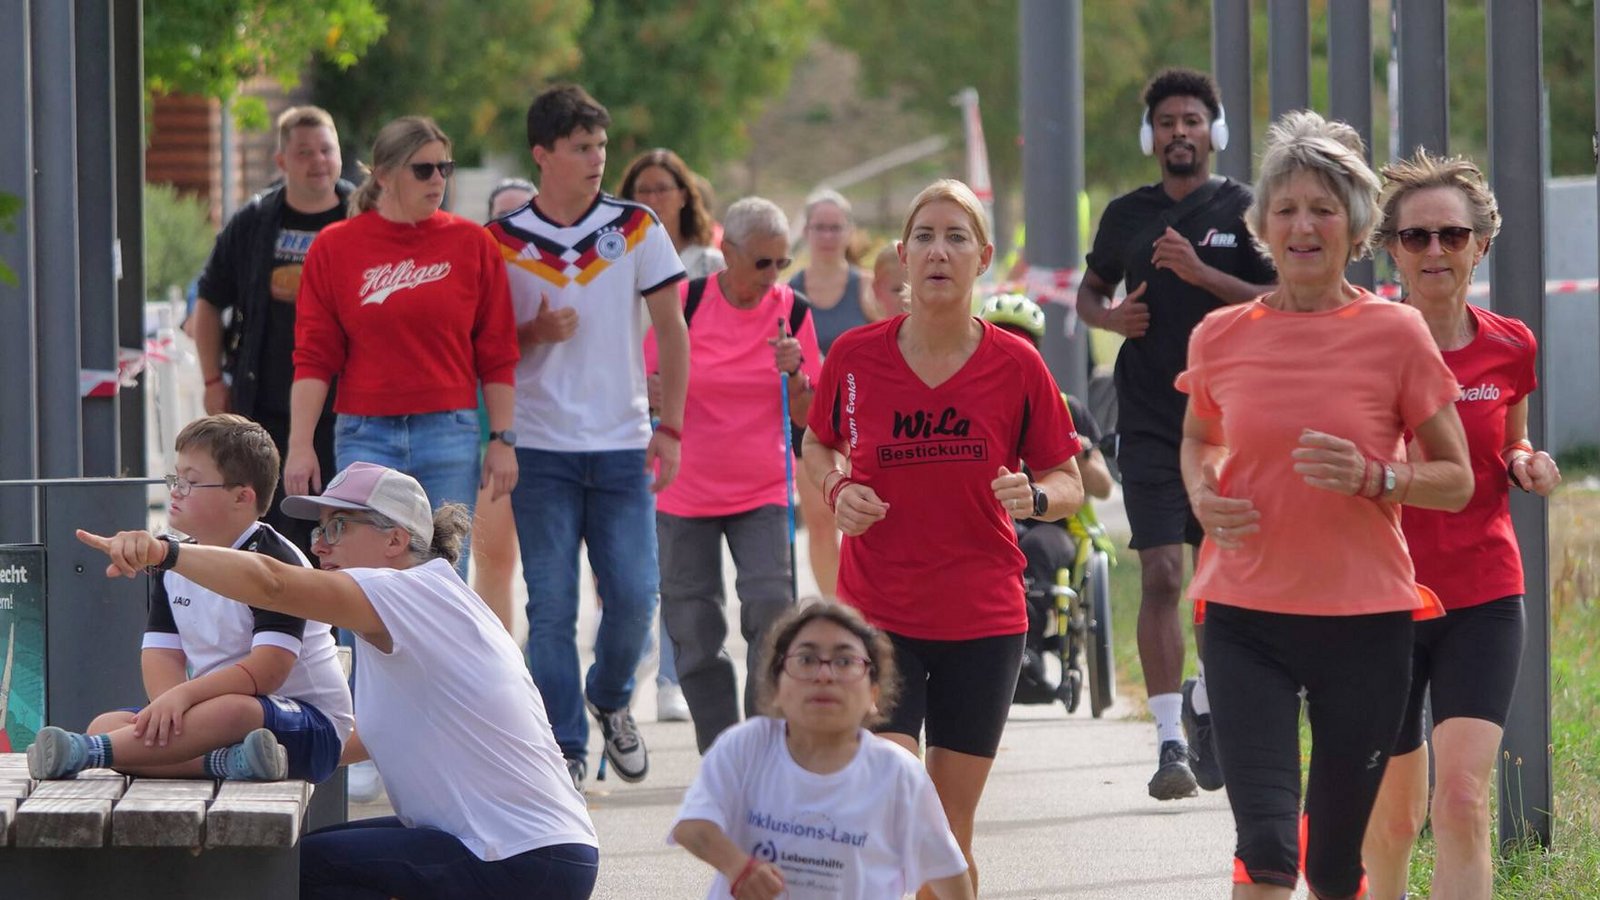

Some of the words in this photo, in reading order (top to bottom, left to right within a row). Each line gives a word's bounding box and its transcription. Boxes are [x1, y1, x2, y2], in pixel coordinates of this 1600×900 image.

[359, 258, 452, 298] Hilfiger
[847, 372, 856, 414] Evaldo
[892, 407, 970, 438] WiLa
[881, 444, 983, 461] Bestickung
